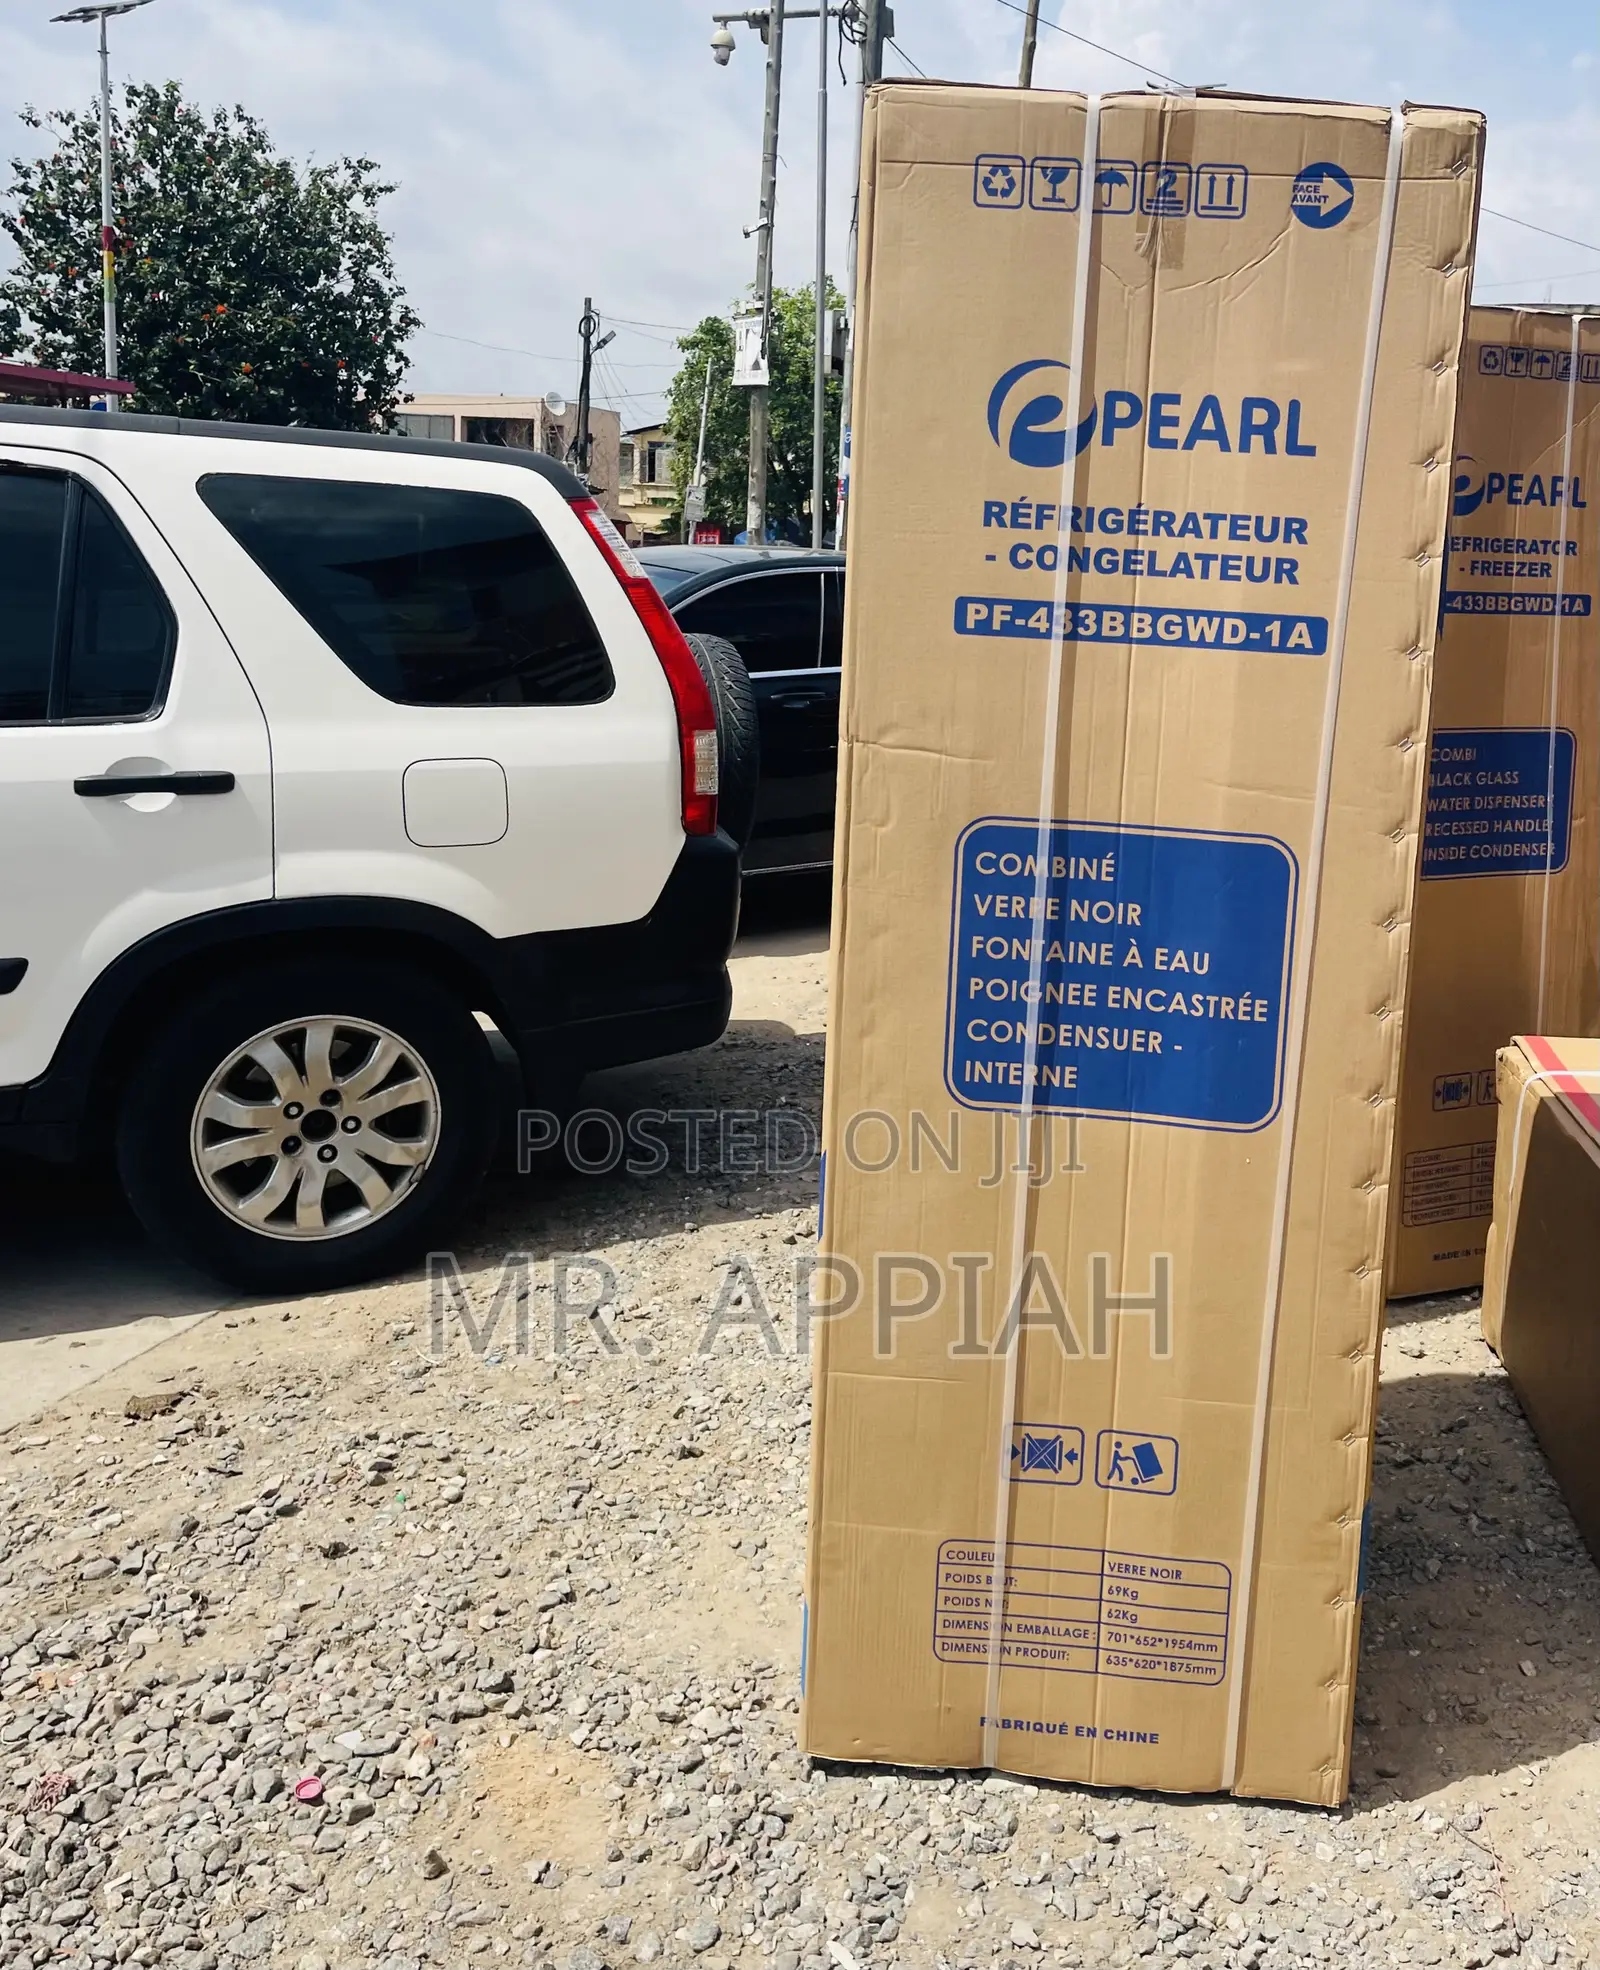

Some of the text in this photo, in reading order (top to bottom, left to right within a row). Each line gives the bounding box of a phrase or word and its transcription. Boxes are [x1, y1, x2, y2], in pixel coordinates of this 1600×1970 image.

[1292, 184, 1320, 194] FACE
[1291, 194, 1329, 204] AVANT
[1101, 390, 1317, 457] PEARL
[982, 495, 1309, 545] RÉFRIGÉRATEUR
[1448, 536, 1577, 556] EFRIGERATOR
[1008, 542, 1300, 585] CONGELATEUR
[1470, 560, 1552, 578] FREEZER
[965, 602, 1314, 649] PF-433BBGWD-1A
[1430, 747, 1477, 762] COMBI
[1476, 771, 1519, 785] GLASS
[1427, 794, 1545, 812] WATER DISPENSER
[1425, 820, 1489, 837] RECESSED
[1423, 842, 1555, 862] INSIDE CONDENSER
[975, 852, 1115, 882] COMBINÉ
[1070, 899, 1142, 927] NOIR
[971, 935, 1210, 975] FONTAINE À EAU
[969, 977, 1268, 1022] POIGNEE ENCASTRÉE
[966, 1018, 1163, 1054] CONDENSUER
[964, 1060, 1078, 1089] INTERNE
[946, 1550, 995, 1562] COULEU
[944, 1573, 982, 1585] POIDS
[1108, 1561, 1182, 1580] VERRE NOIR
[943, 1595, 980, 1608] POIDS
[1107, 1585, 1139, 1600] 69Kg
[1107, 1608, 1138, 1624] 62Kg
[1016, 1623, 1090, 1640] EMBALLAGE
[1015, 1646, 1070, 1661] PRODUIT:
[979, 1715, 1160, 1744] FABRIQUÉ EN CHINE
